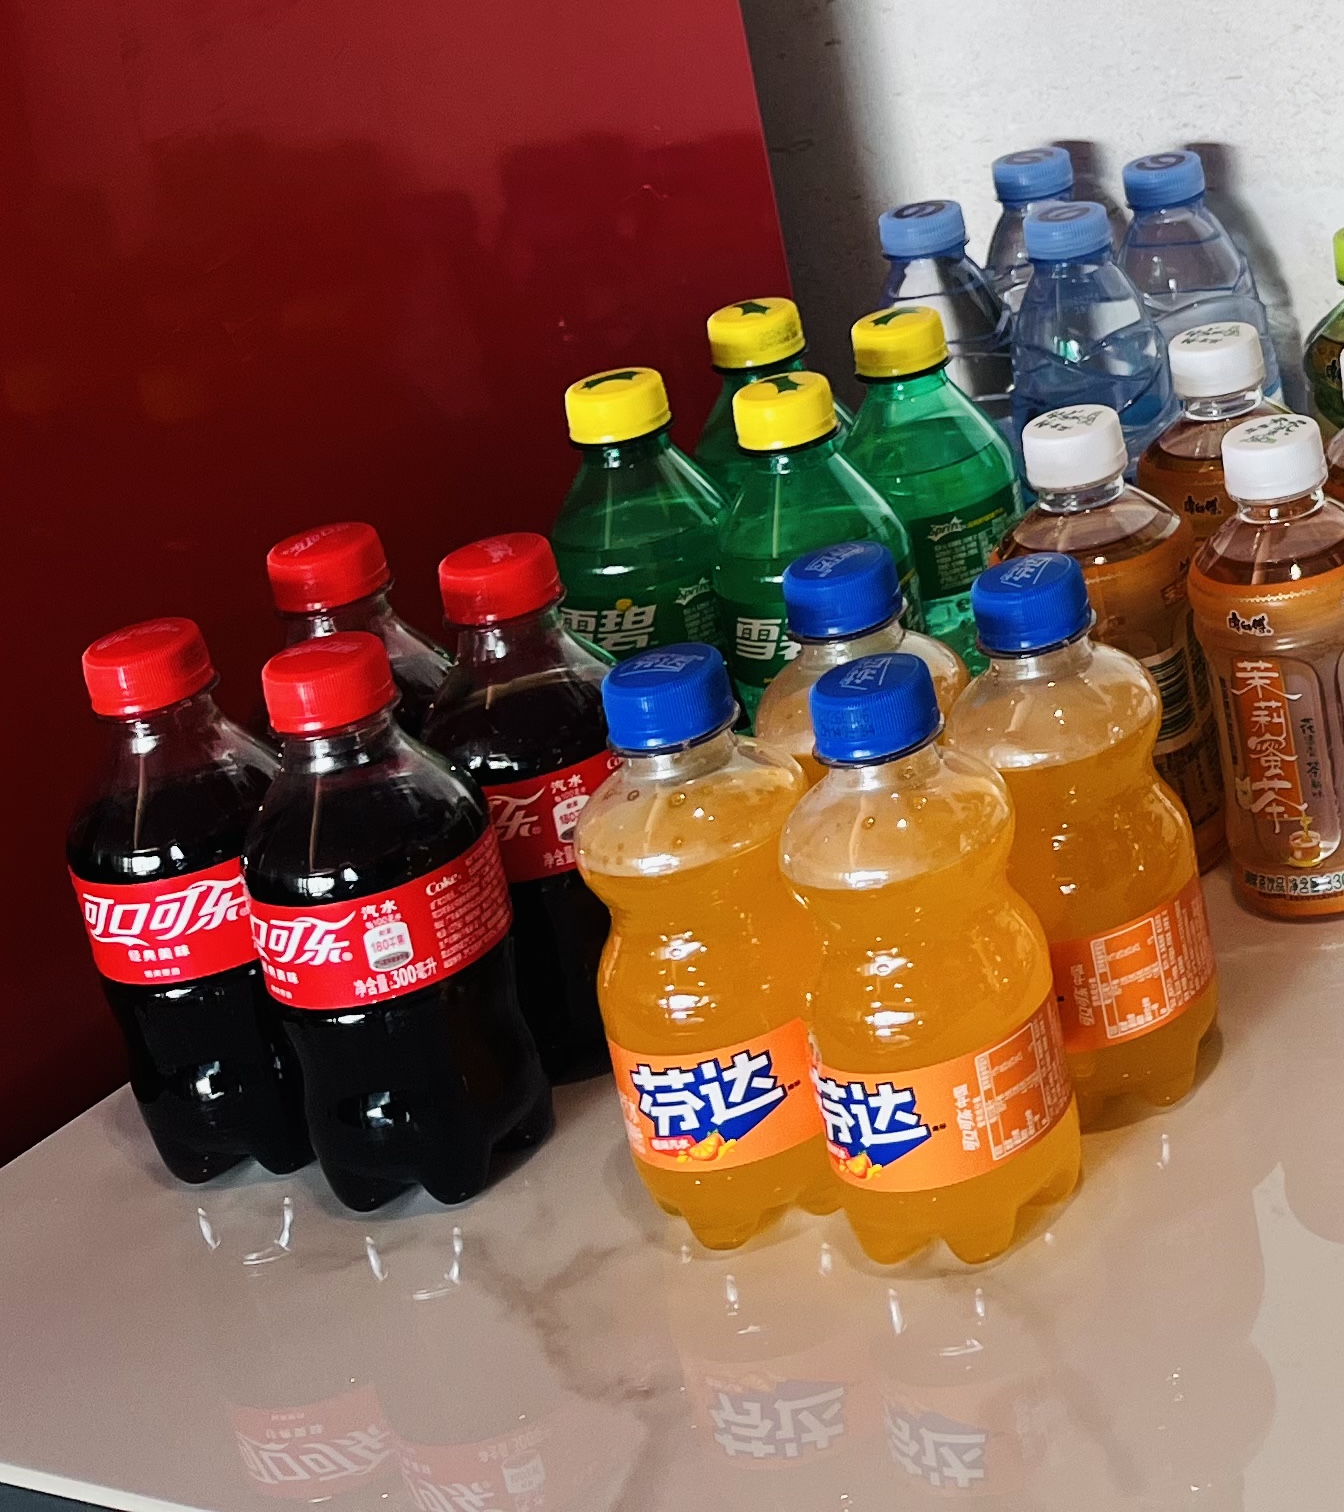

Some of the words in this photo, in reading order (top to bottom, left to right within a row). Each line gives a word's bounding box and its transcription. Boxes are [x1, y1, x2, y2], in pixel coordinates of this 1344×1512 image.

[561, 604, 657, 652] 雪碧
[1231, 659, 1309, 834] 茉莉蜜茶
[82, 874, 248, 947] 可口可乐
[360, 899, 398, 921] 汽水
[425, 873, 458, 897] Coke
[250, 909, 357, 967] 口可乐
[630, 1051, 787, 1138] 芬达
[810, 1067, 930, 1149] 芬达
